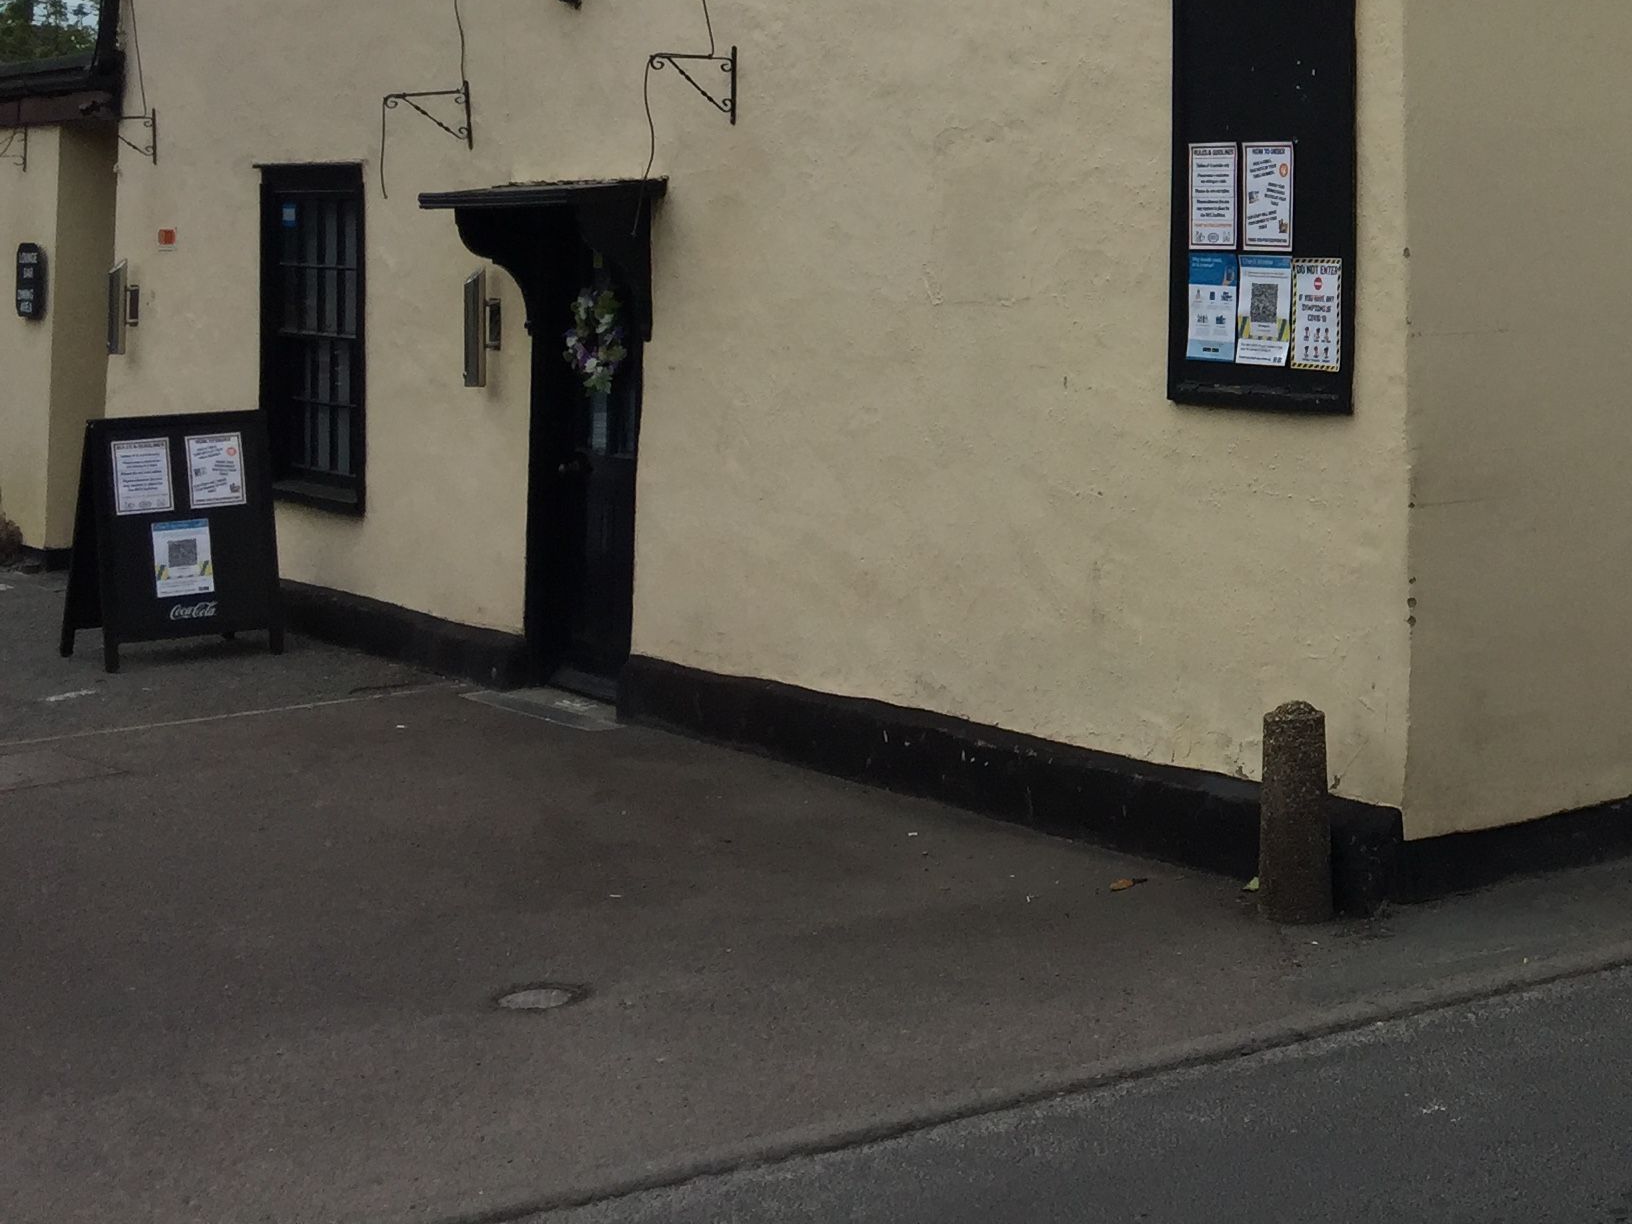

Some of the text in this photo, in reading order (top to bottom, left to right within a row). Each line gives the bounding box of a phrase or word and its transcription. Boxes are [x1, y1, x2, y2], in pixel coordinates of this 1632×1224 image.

[1296, 264, 1306, 275] DO
[1307, 264, 1319, 275] NOT
[1320, 265, 1338, 276] ENTER
